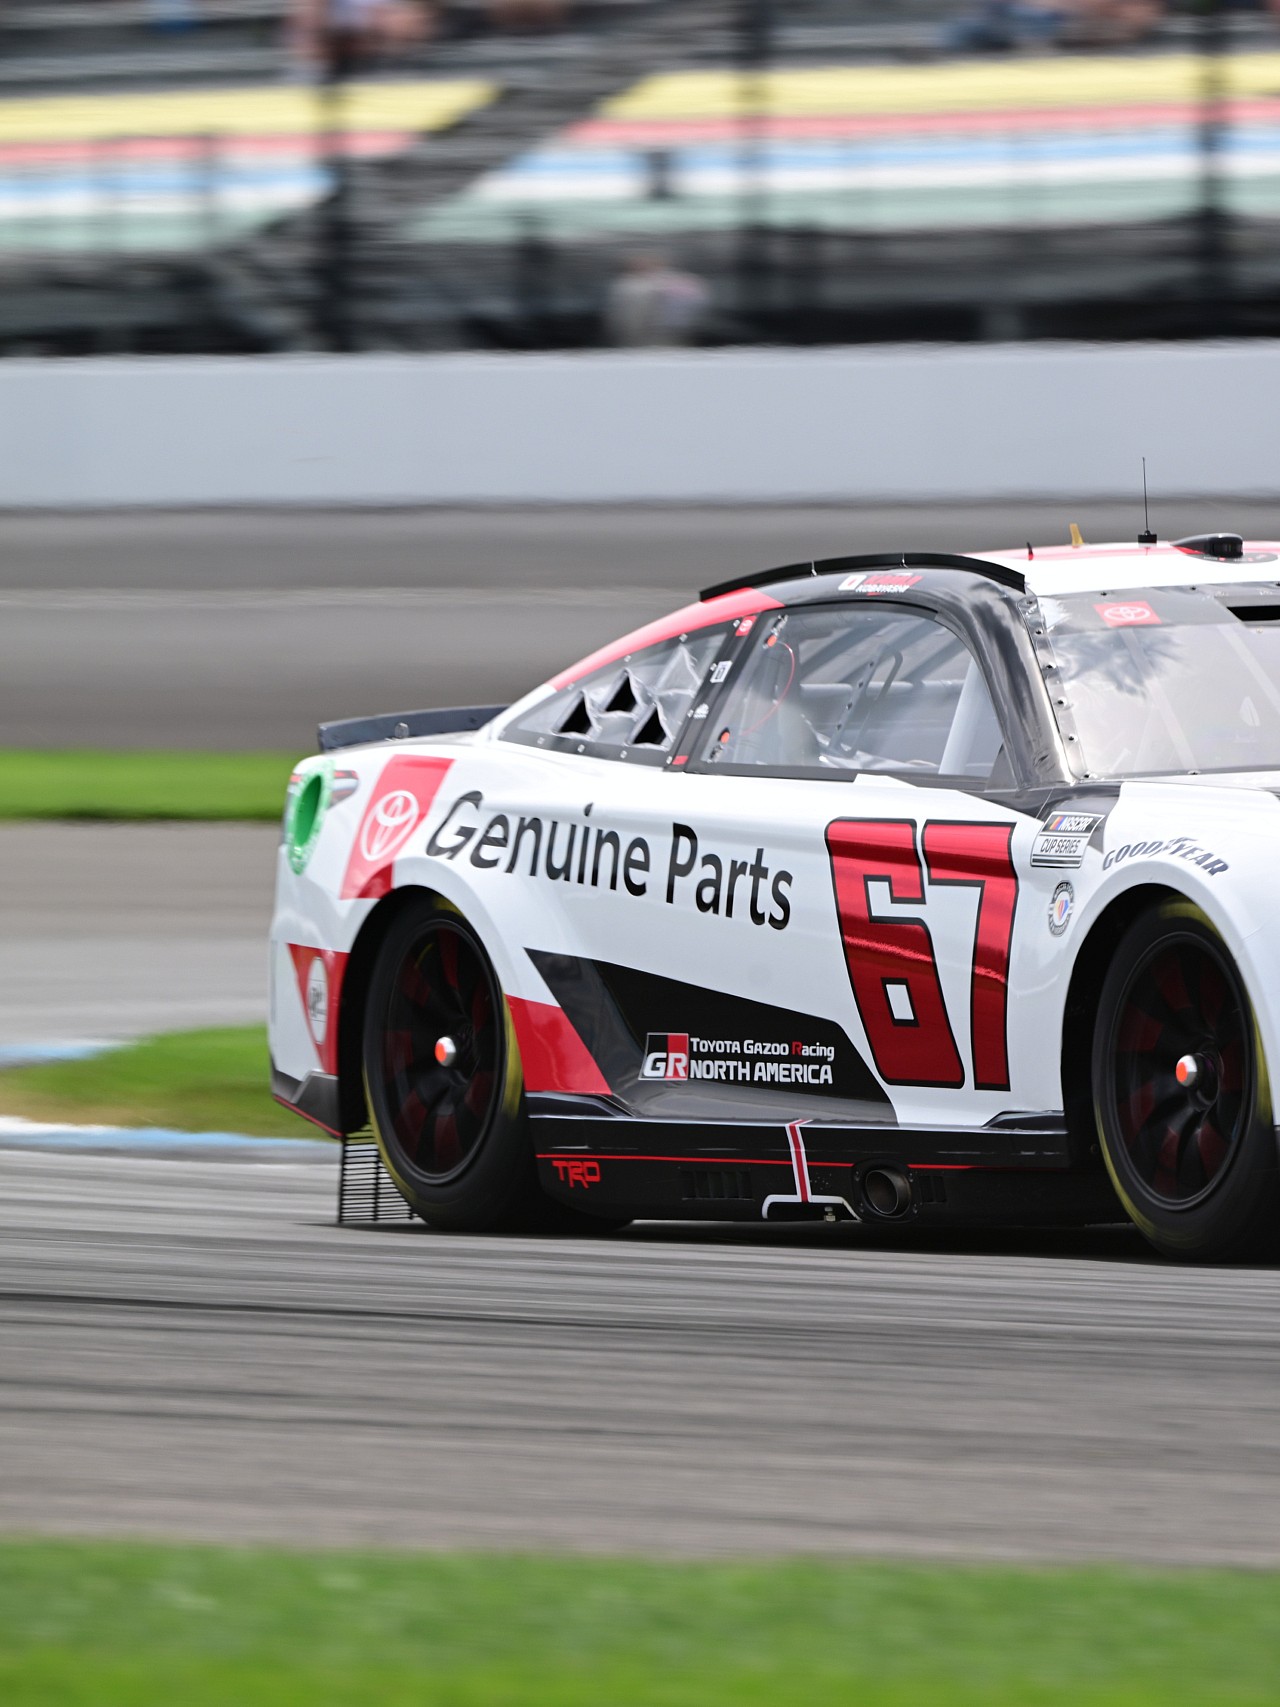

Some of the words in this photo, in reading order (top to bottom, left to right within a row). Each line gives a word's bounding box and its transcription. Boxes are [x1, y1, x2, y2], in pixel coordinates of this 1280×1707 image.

[1040, 838, 1057, 853] CUP
[1055, 838, 1081, 854] SERIES
[425, 790, 650, 897] Genuine
[665, 822, 793, 930] Parts
[824, 816, 1020, 1092] 67
[690, 1037, 741, 1054] TOYOTA
[743, 1039, 789, 1056] GAZOO
[791, 1041, 835, 1062] Racing
[643, 1052, 688, 1078] GR
[690, 1060, 750, 1081] NORTH
[753, 1062, 834, 1084] AMERICA
[552, 1160, 601, 1189] TRD
